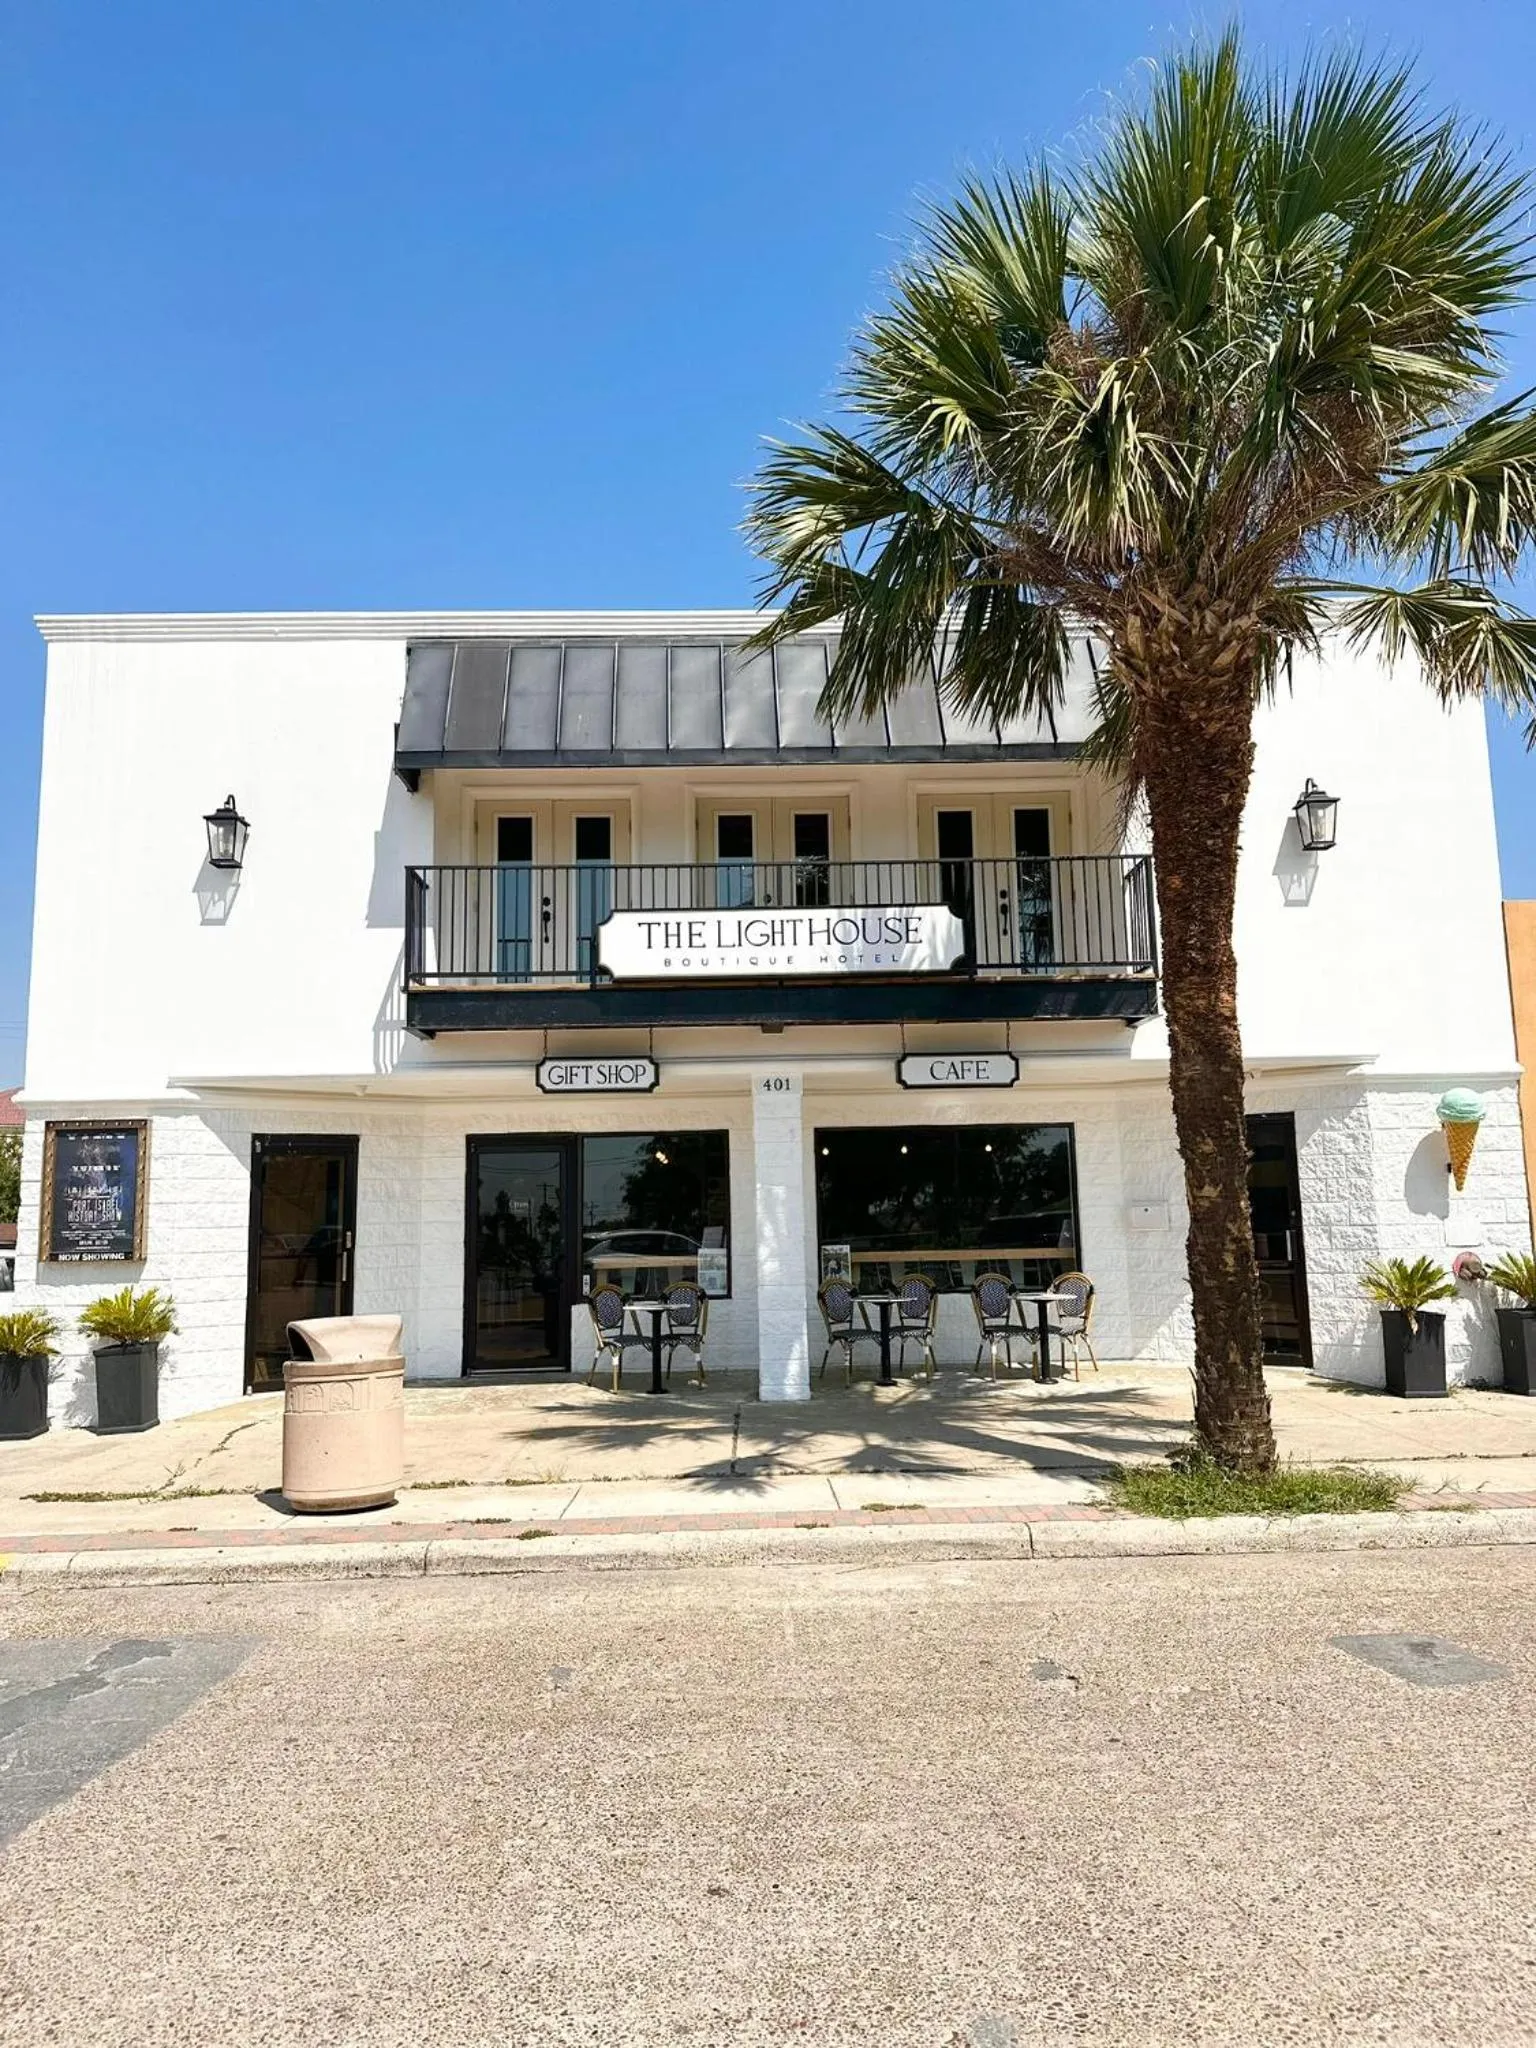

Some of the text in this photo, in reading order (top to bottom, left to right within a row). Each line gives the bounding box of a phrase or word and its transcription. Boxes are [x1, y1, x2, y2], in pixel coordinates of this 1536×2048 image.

[638, 917, 923, 949] THE LIGHTHOUSE
[664, 953, 899, 967] BOUTIQUE HOTEL
[548, 1064, 647, 1085] GIFT SHOP
[929, 1060, 990, 1081] CAFE
[763, 1078, 792, 1092] 401
[58, 1252, 125, 1261] NOW SHOWING
